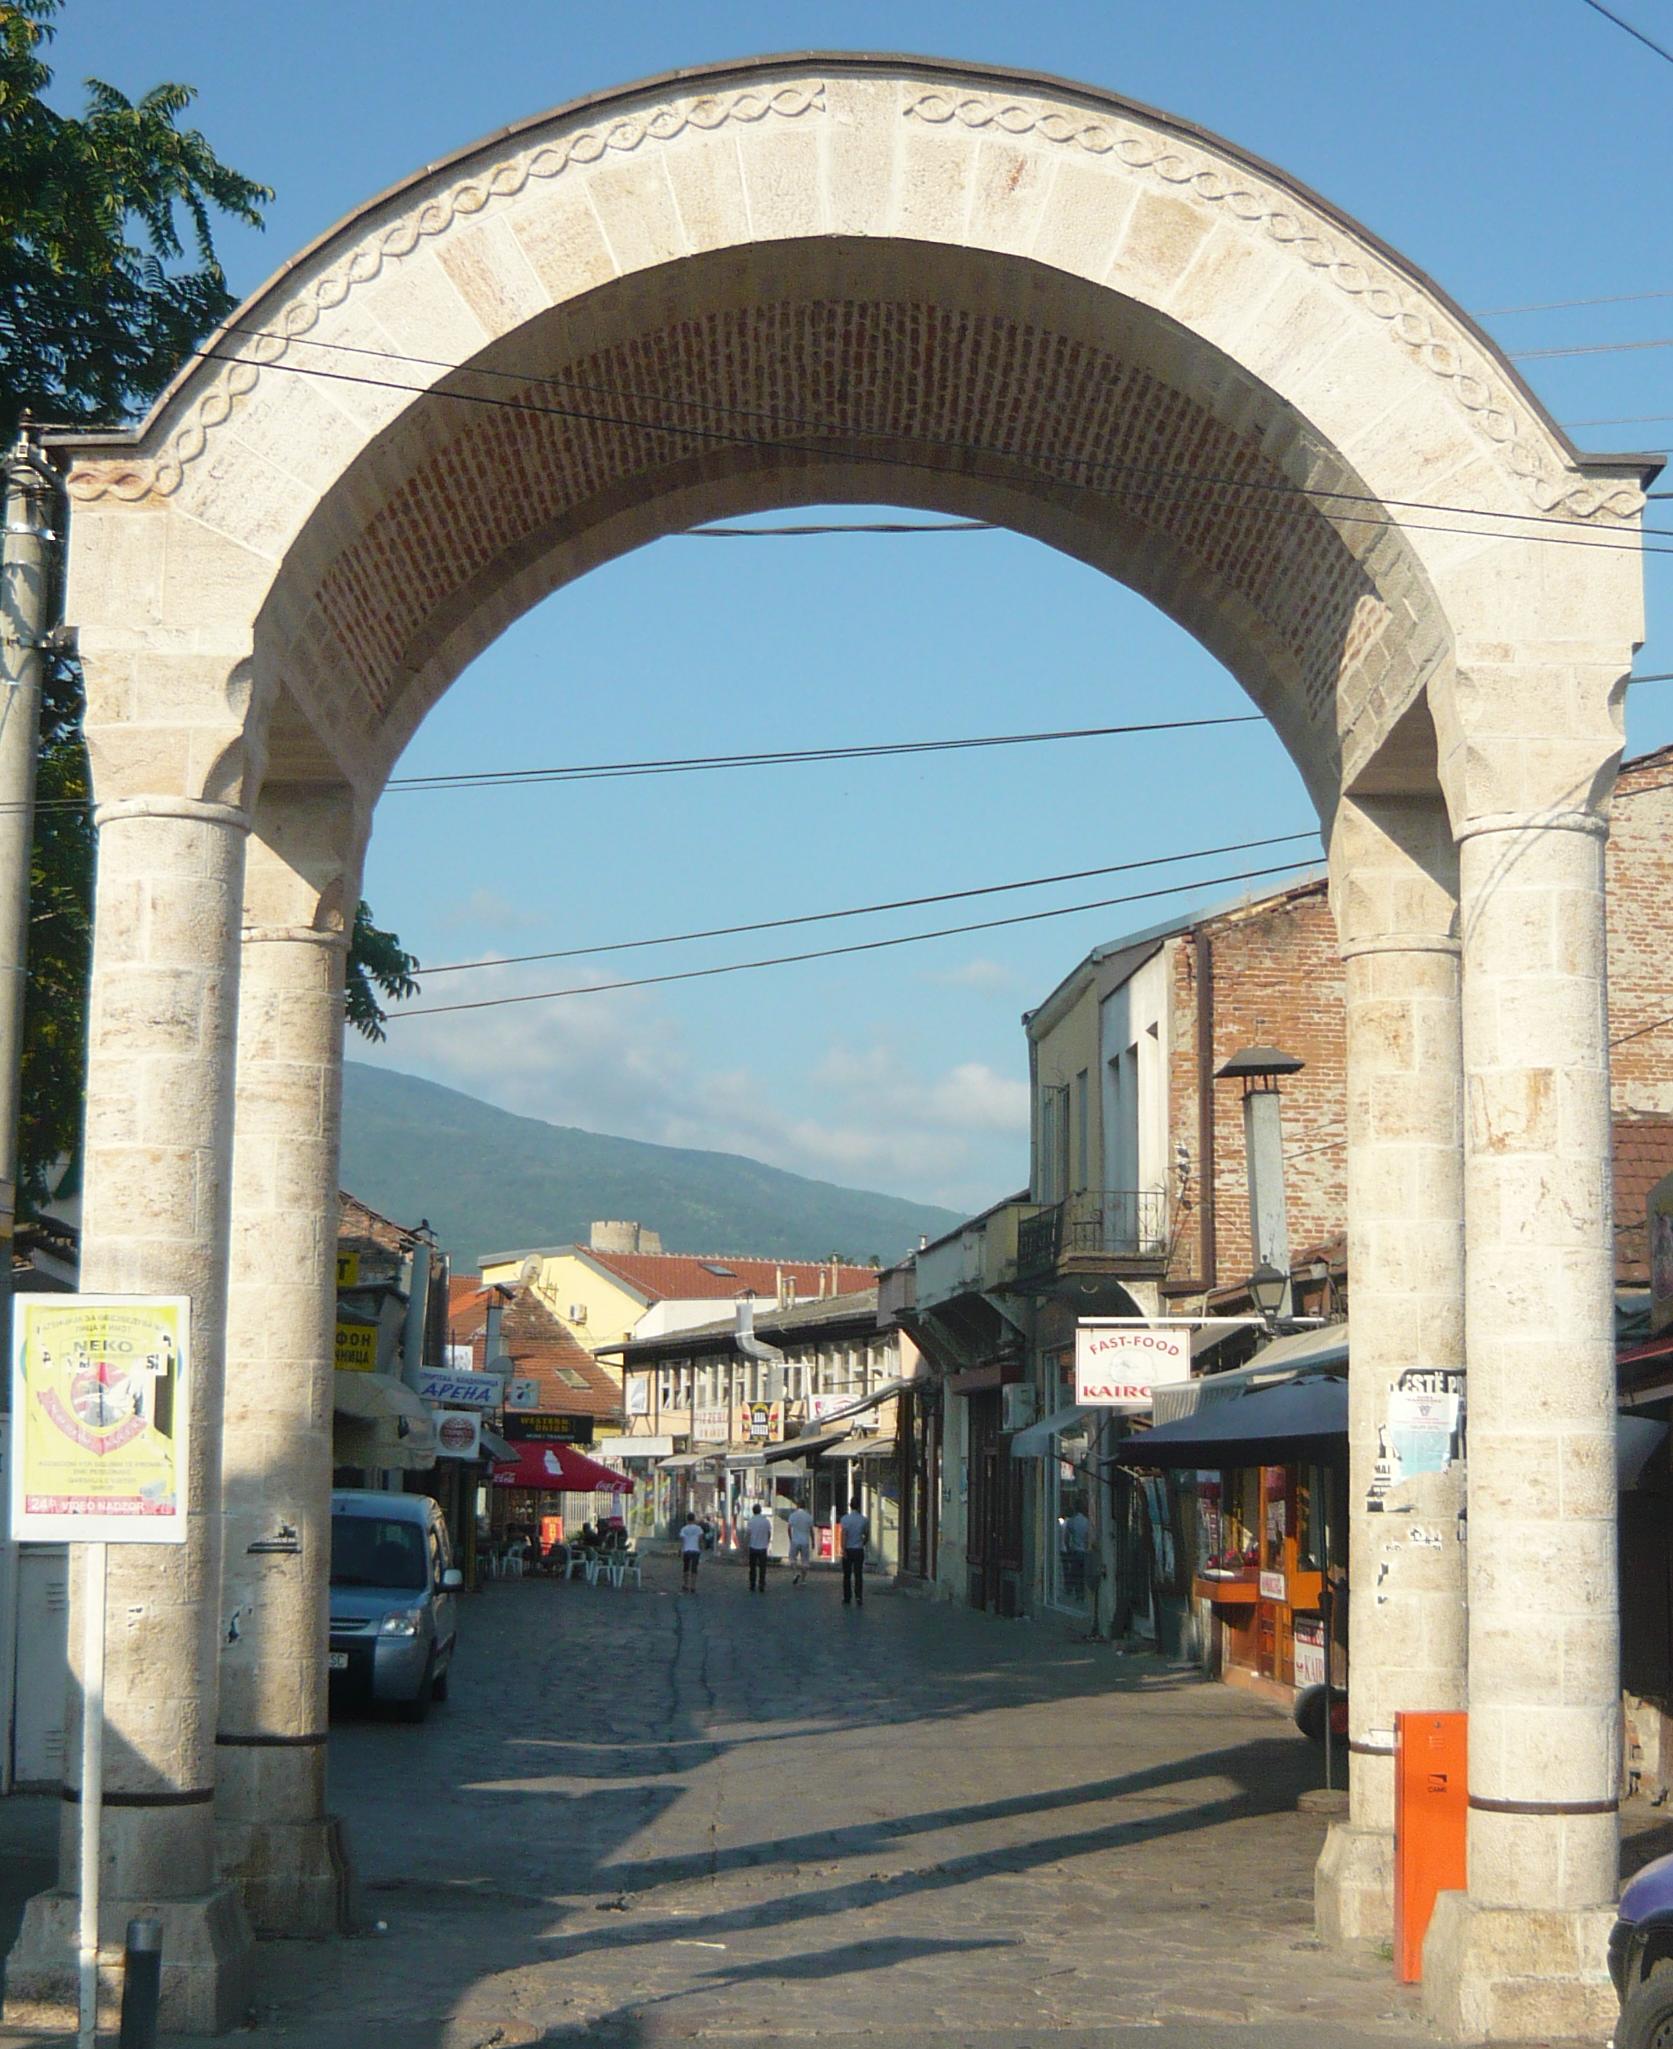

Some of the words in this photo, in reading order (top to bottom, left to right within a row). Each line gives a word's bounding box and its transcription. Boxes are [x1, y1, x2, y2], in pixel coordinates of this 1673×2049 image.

[73, 1339, 133, 1353] NEKO
[1089, 1335, 1180, 1356] FAST-FOOD
[421, 1382, 492, 1402] АРЕНА
[61, 1501, 96, 1511] VIDEO
